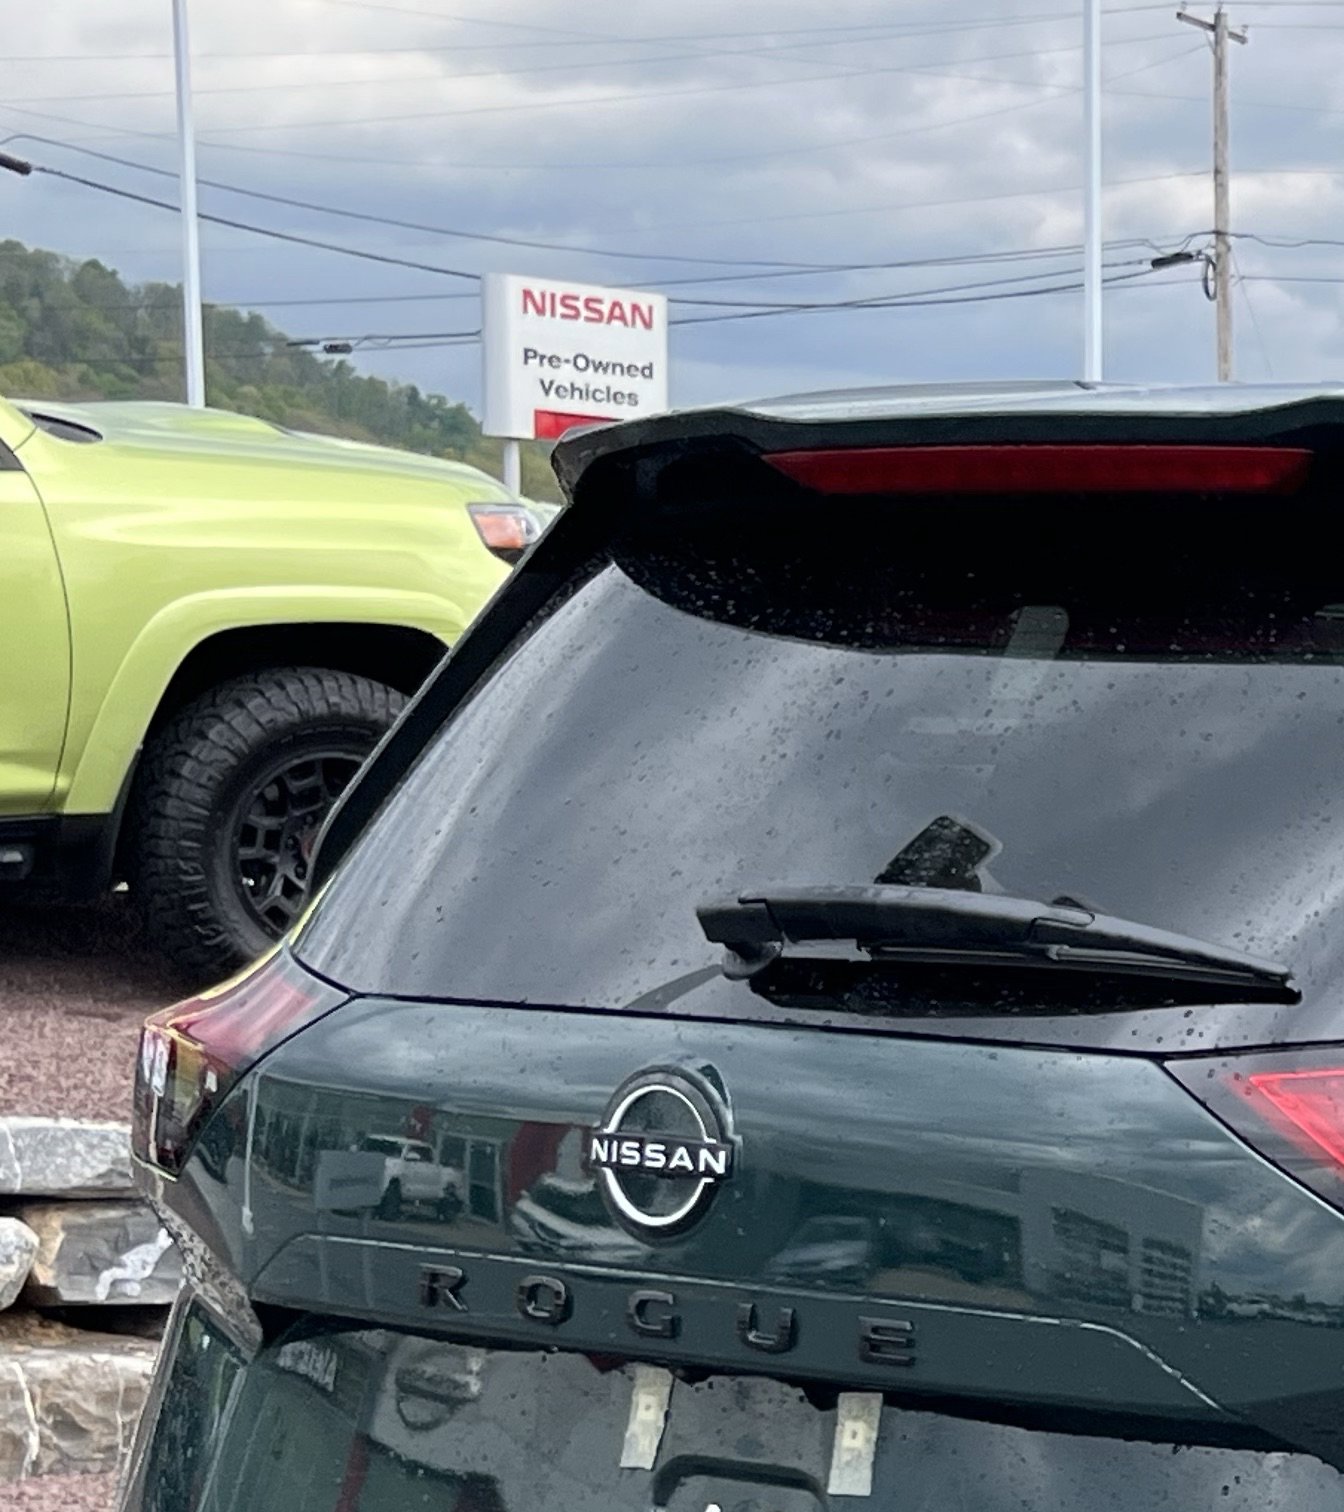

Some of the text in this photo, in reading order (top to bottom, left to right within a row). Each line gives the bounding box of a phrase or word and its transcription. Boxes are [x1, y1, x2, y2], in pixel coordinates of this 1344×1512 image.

[522, 288, 654, 331] NISSAN
[523, 347, 654, 380] Pre-Owned
[539, 378, 639, 407] Vehicles
[591, 1137, 728, 1175] NISSAN
[420, 1262, 916, 1367] ROGUE
